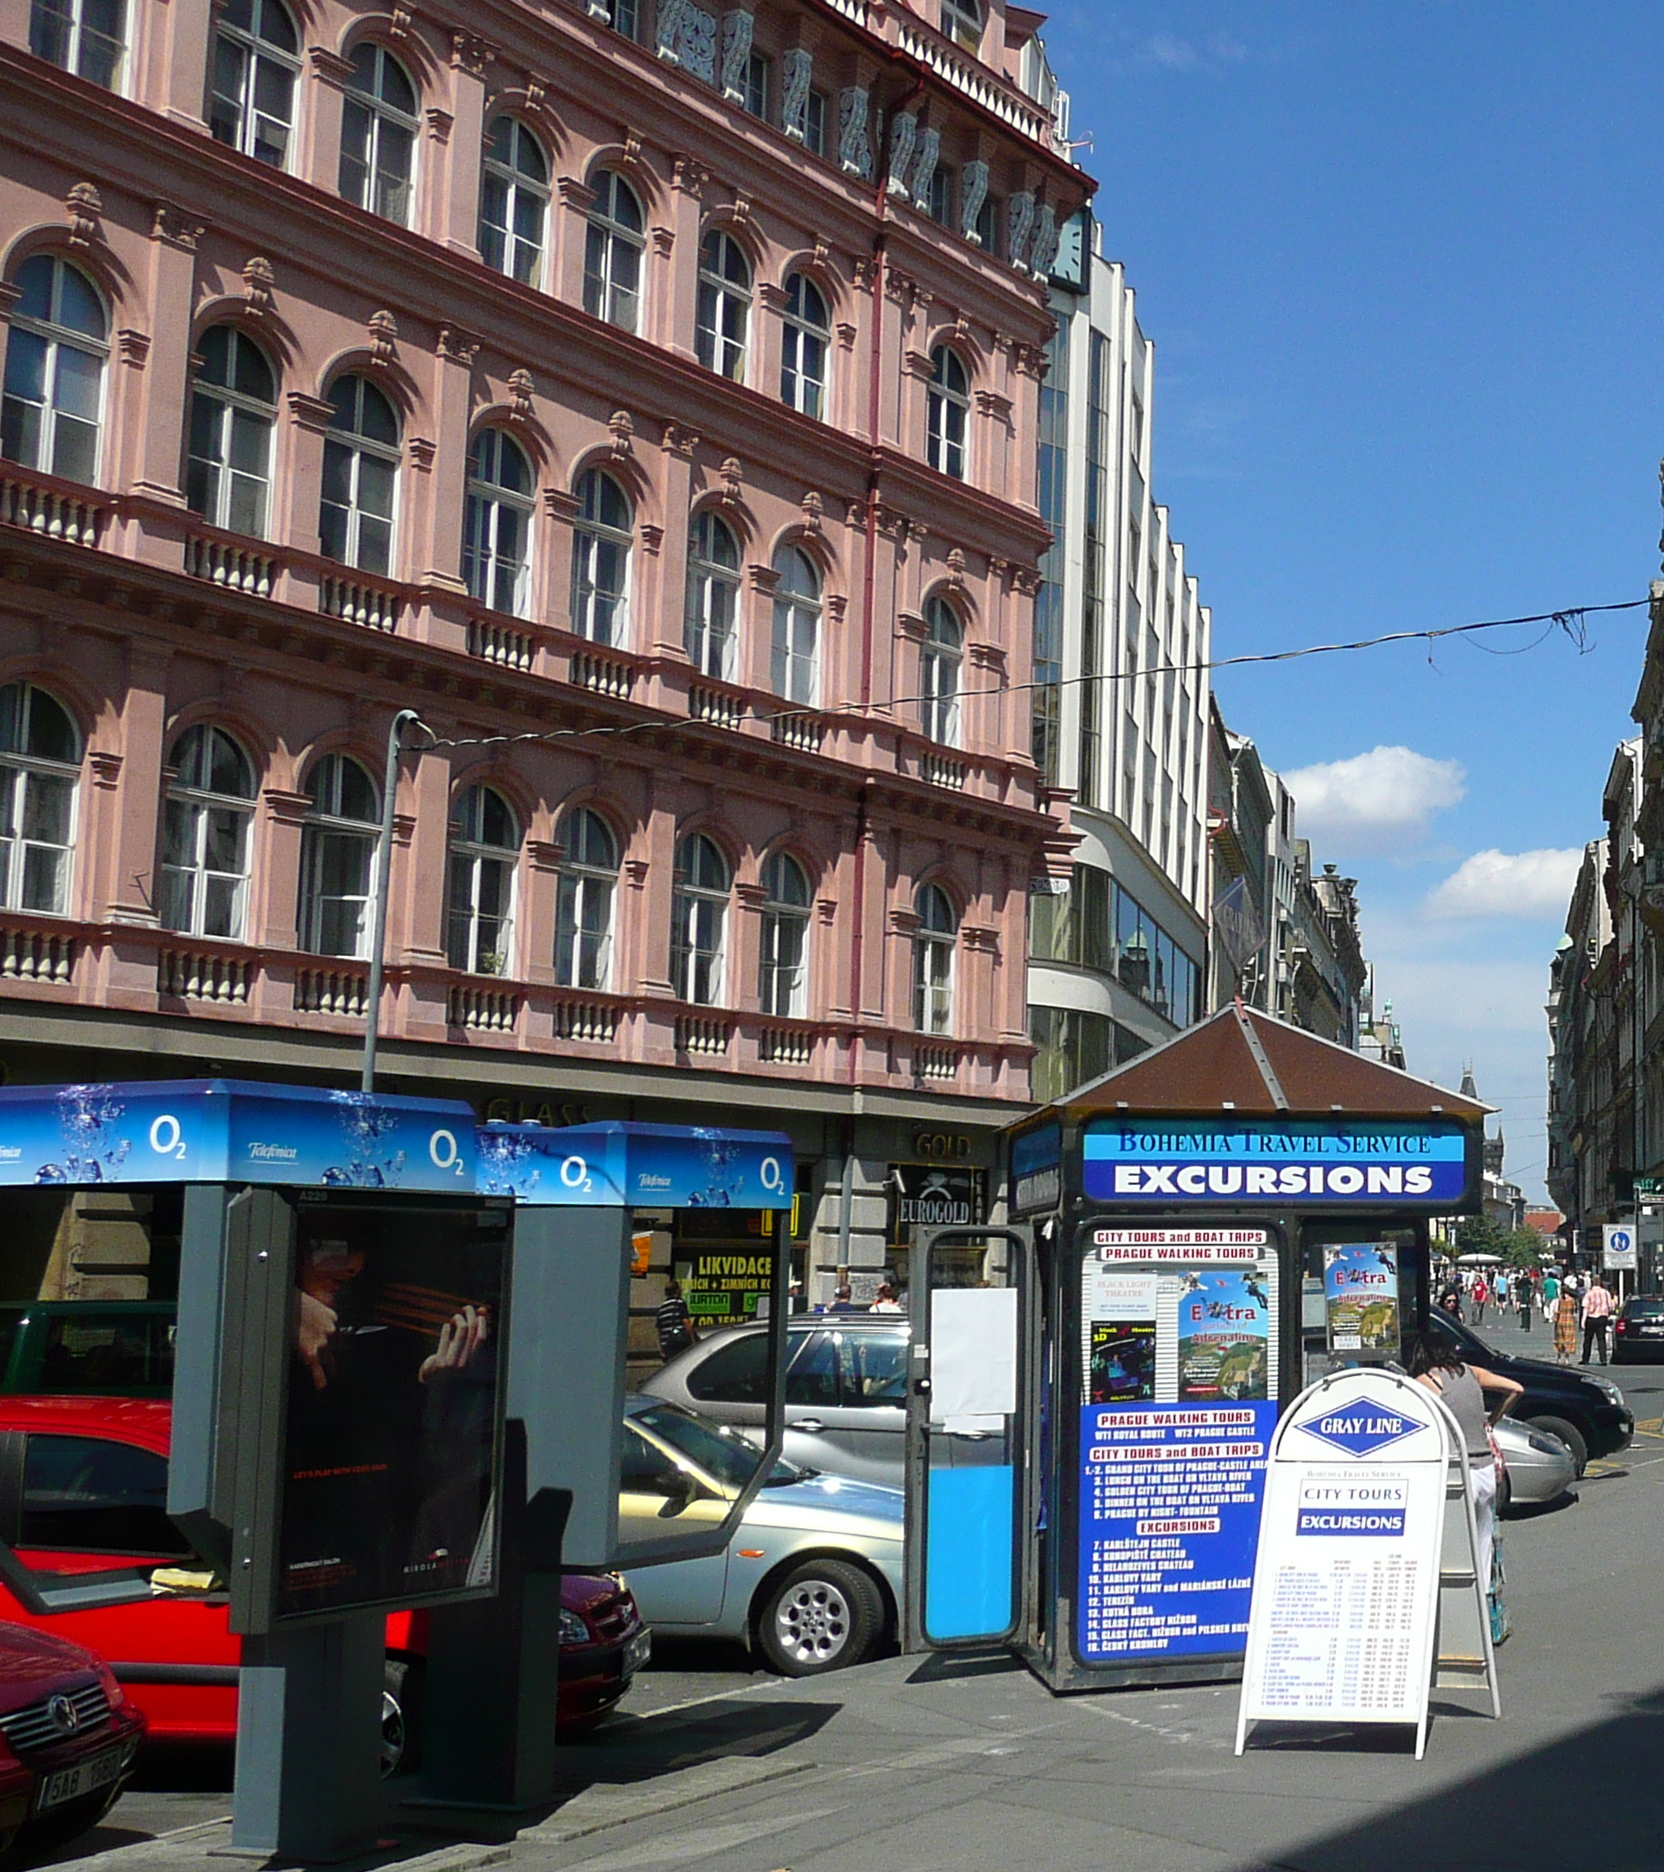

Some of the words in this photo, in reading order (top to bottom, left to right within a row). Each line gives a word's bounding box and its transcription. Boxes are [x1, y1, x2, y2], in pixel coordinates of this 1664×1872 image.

[917, 1134, 971, 1159] GOLD
[1119, 1128, 1232, 1153] BOHEMIA
[1239, 1128, 1329, 1153] TRAVEL
[1336, 1129, 1431, 1154] SERVICE
[1114, 1165, 1433, 1194] EXCURSIONS
[900, 1200, 970, 1224] EUROGOLD
[1097, 1232, 1123, 1242] CITY
[1128, 1232, 1165, 1242] TOURS
[1169, 1232, 1190, 1242] and
[1195, 1232, 1224, 1242] BOAT
[1229, 1232, 1262, 1242] TRIPS
[1106, 1248, 1153, 1259] PRAGUE
[1158, 1248, 1212, 1259] WALKING
[1216, 1248, 1255, 1259] TOURS
[699, 1257, 771, 1275] LIKVIDACE
[1335, 1270, 1387, 1285] Etra
[1191, 1304, 1257, 1321] Etra
[1191, 1332, 1257, 1343] Adrenaline
[1101, 1414, 1149, 1425] PRAGUE
[1153, 1413, 1208, 1424] WALKING
[1213, 1412, 1251, 1422] TOURS
[1320, 1418, 1364, 1434] GRAY
[1366, 1418, 1402, 1434] LINE
[1113, 1430, 1139, 1440] ROYAL
[1140, 1429, 1165, 1439] ROUTE
[1194, 1428, 1225, 1438] PRAGUE
[1227, 1427, 1255, 1436] CASTLE
[1093, 1450, 1119, 1460] CITY
[1124, 1448, 1161, 1459] TOURS
[1165, 1447, 1187, 1458] and
[1191, 1446, 1221, 1456] BOAT
[1225, 1445, 1259, 1455] TRIPS
[1305, 1488, 1342, 1500] CITY
[1348, 1488, 1402, 1500] TOURS
[1141, 1520, 1215, 1533] EXCURSIONS
[1300, 1515, 1402, 1530] EXCURSIONS
[1151, 1538, 1180, 1548] CASTLE
